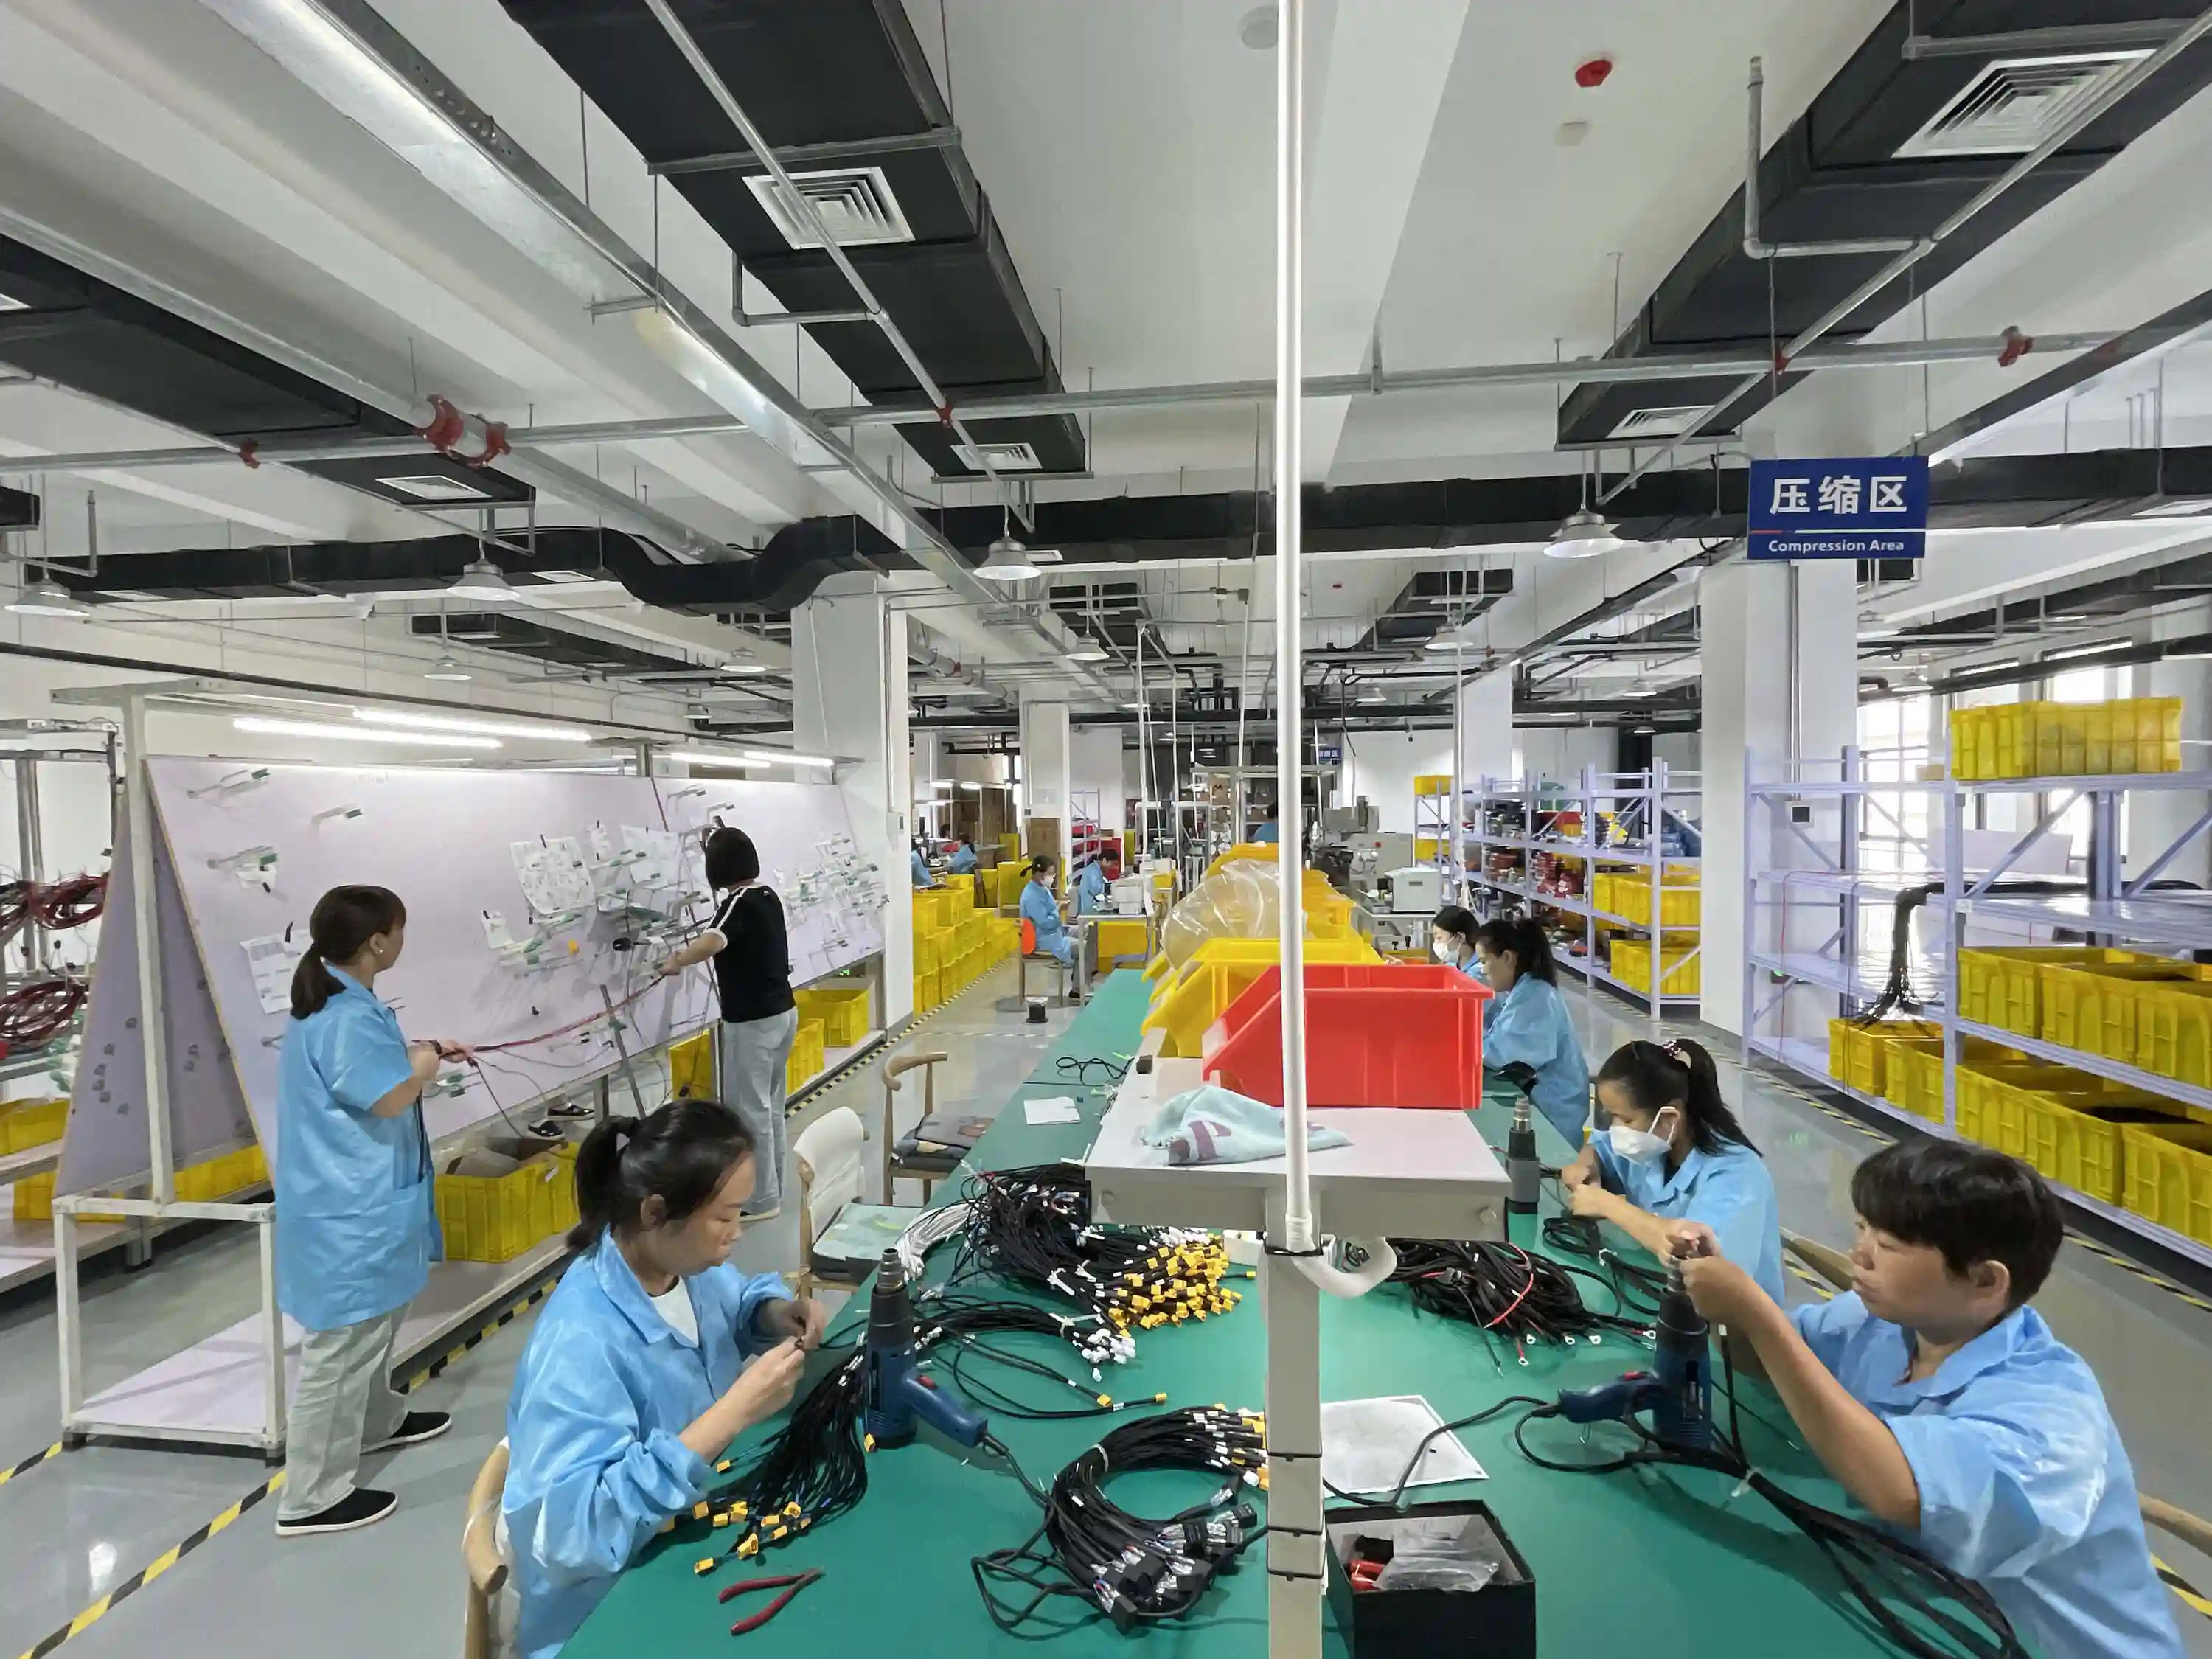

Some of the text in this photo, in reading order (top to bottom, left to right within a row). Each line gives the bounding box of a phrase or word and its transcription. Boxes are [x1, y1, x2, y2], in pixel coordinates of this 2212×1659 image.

[1770, 475, 1907, 515] 压缩区
[1768, 540, 1904, 554] Compression Area
